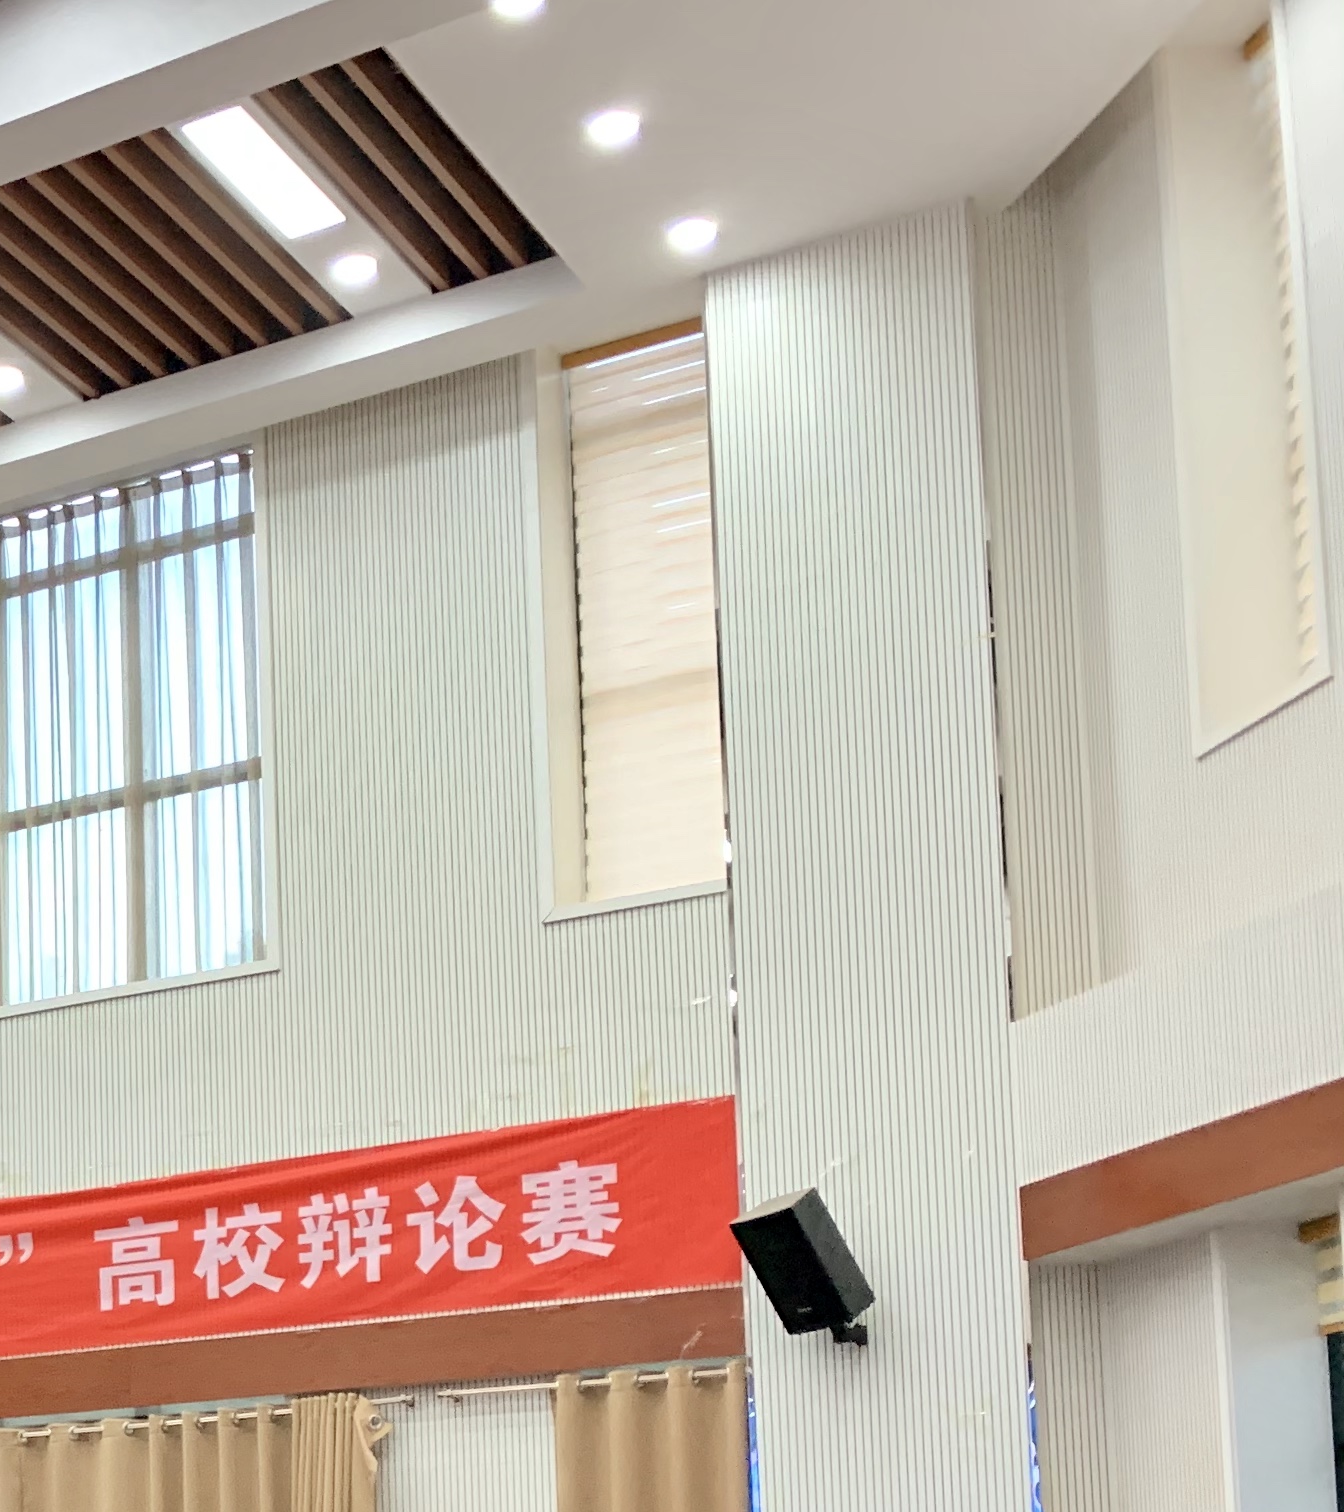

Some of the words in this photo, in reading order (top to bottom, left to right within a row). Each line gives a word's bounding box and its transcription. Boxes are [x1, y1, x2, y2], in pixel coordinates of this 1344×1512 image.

[93, 1159, 621, 1312] 高校辩论赛
